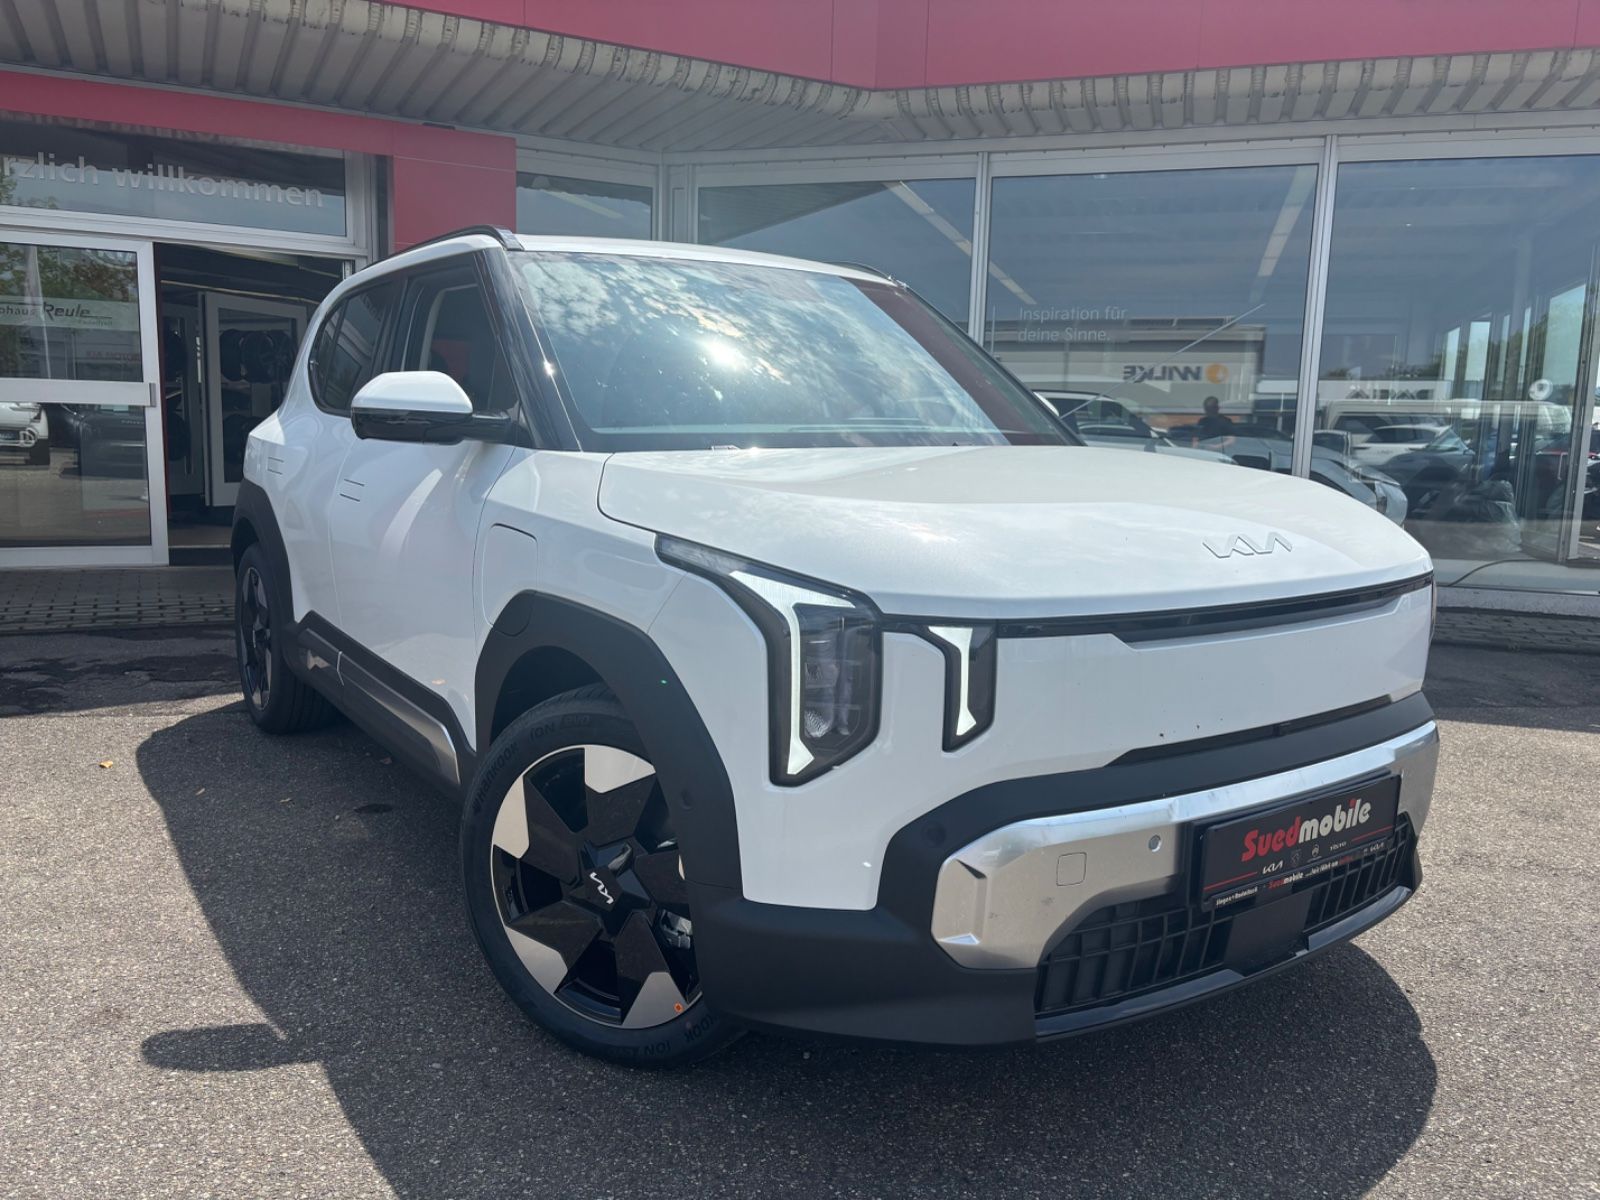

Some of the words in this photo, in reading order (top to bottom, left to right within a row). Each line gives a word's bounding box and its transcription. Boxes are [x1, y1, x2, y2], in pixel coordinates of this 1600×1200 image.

[112, 163, 324, 208] willkommen
[43, 301, 91, 321] Reule
[1020, 306, 1099, 323] Inspiration
[1105, 305, 1128, 320] für
[1018, 327, 1060, 341] deine
[1064, 327, 1110, 341] Sinne.
[1241, 798, 1372, 862] Suedmobile
[1262, 860, 1284, 875] KIA
